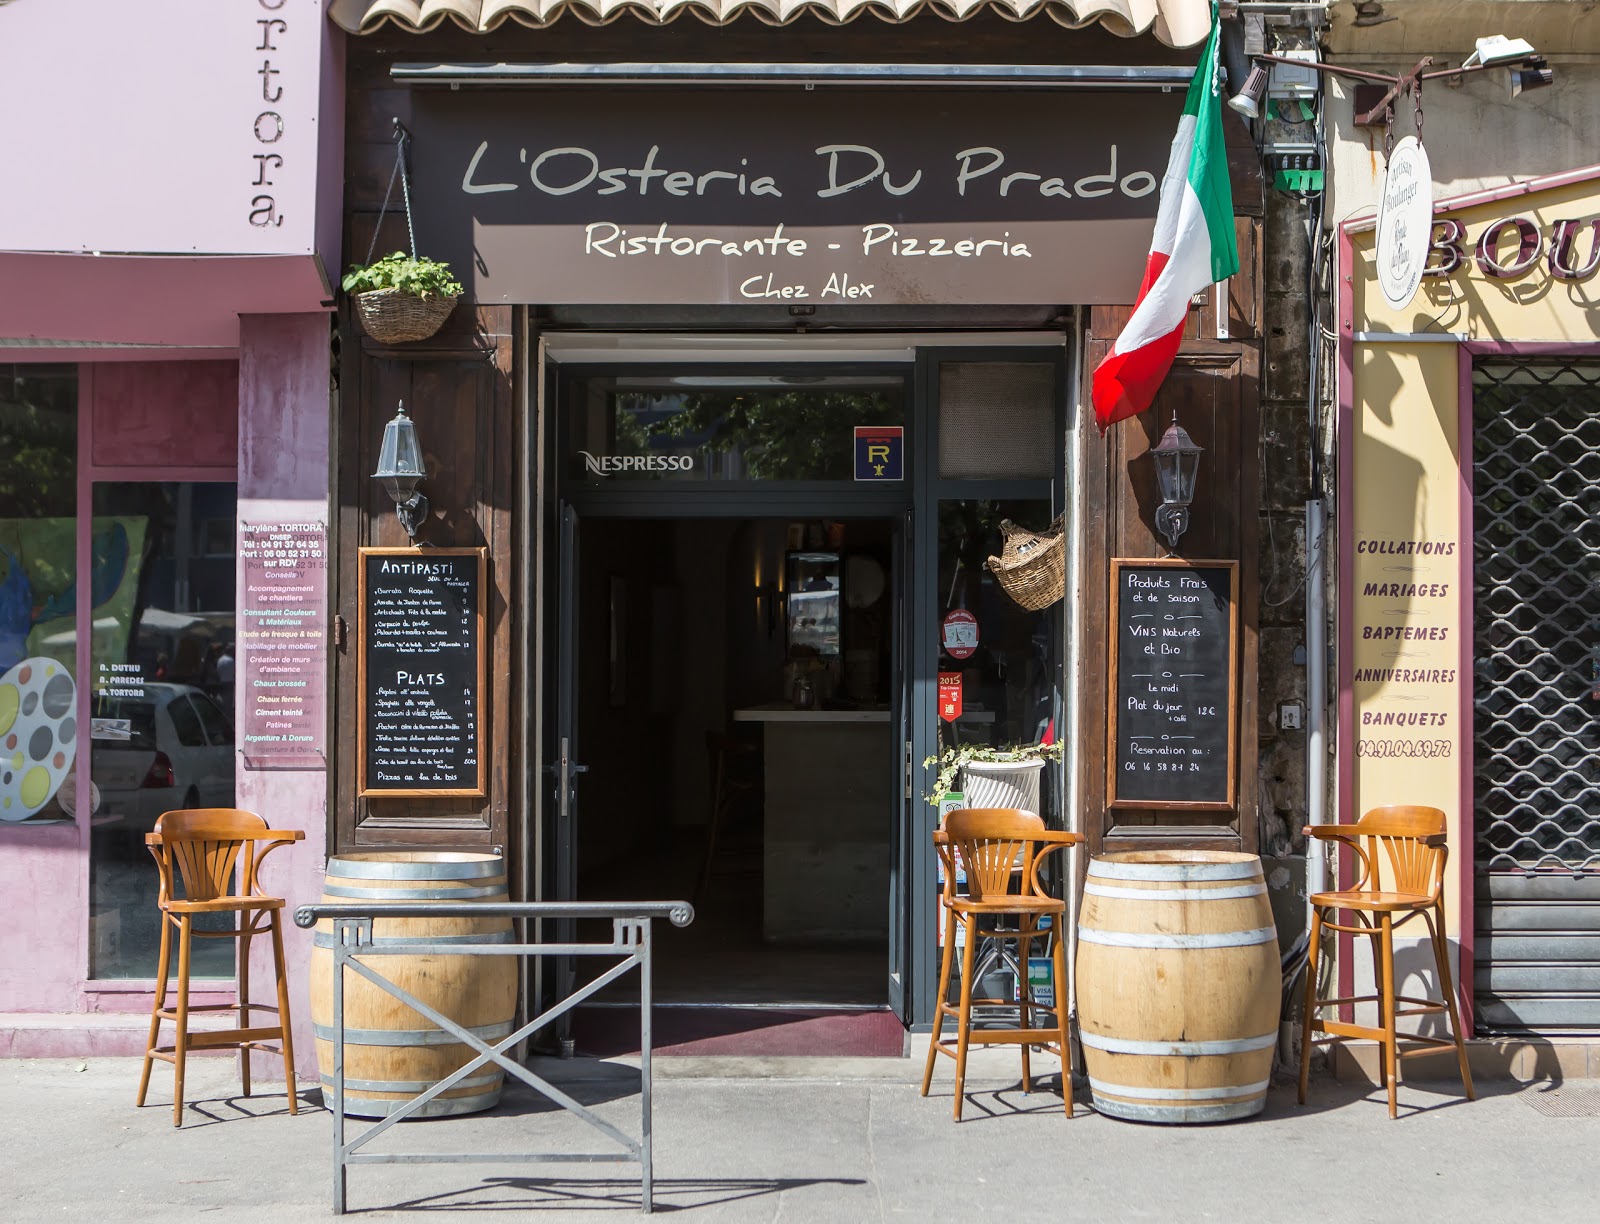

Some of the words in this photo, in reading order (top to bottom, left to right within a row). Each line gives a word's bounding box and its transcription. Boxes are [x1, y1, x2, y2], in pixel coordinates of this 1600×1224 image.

[462, 140, 782, 196] L'Osteria
[815, 144, 922, 198] Du
[956, 143, 1156, 198] Prado
[1385, 181, 1418, 213] Boulanger
[584, 221, 808, 258] Ristorante
[862, 222, 1032, 258] Pizzeria
[740, 271, 813, 299] Chez
[820, 271, 875, 298] Alex
[868, 445, 890, 463] R
[240, 524, 278, 534] Marylène
[279, 524, 322, 532] TORTORA
[1357, 540, 1455, 555] COLLATIONS
[240, 550, 257, 558] Port
[264, 550, 274, 558] 06
[276, 550, 286, 558] 09
[288, 550, 298, 558] 52
[300, 550, 308, 558] 31
[311, 550, 321, 558] 50
[279, 560, 298, 568] RDV
[265, 571, 296, 579] Conseils
[1128, 574, 1170, 588] Produits
[1180, 577, 1208, 589] Frais
[248, 584, 314, 594] Accompagnement
[1363, 583, 1449, 598] MARIAGES
[1133, 591, 1144, 602] et
[1147, 593, 1159, 602] de
[272, 630, 298, 640] fresque
[1162, 628, 1201, 637] Naturels
[1362, 626, 1449, 641] BAPTEMES
[244, 643, 276, 651] Habillage
[1144, 642, 1155, 654] et
[1161, 642, 1180, 654] Bio
[250, 656, 280, 664] Création
[111, 664, 140, 672] DUTHU
[110, 676, 144, 684] PAREDES
[396, 671, 446, 685] PLATS
[940, 675, 961, 684] 2015
[1355, 668, 1456, 683] ANNIVERSAIRES
[110, 688, 144, 696] TORTORA
[1160, 683, 1178, 692] midi
[1128, 696, 1148, 710] Plat
[1152, 700, 1164, 710] du
[1166, 702, 1183, 714] jour
[1362, 712, 1448, 727] BANQUETS
[265, 721, 292, 729] Patines
[245, 734, 280, 742] Argenture
[1356, 740, 1452, 758] 04.91.04.69.72
[1124, 762, 1136, 771] 06
[1143, 762, 1151, 771] 16
[1157, 763, 1168, 771] 58
[1189, 762, 1200, 772] 24
[378, 771, 400, 780] Pizzas
[433, 772, 442, 780] de
